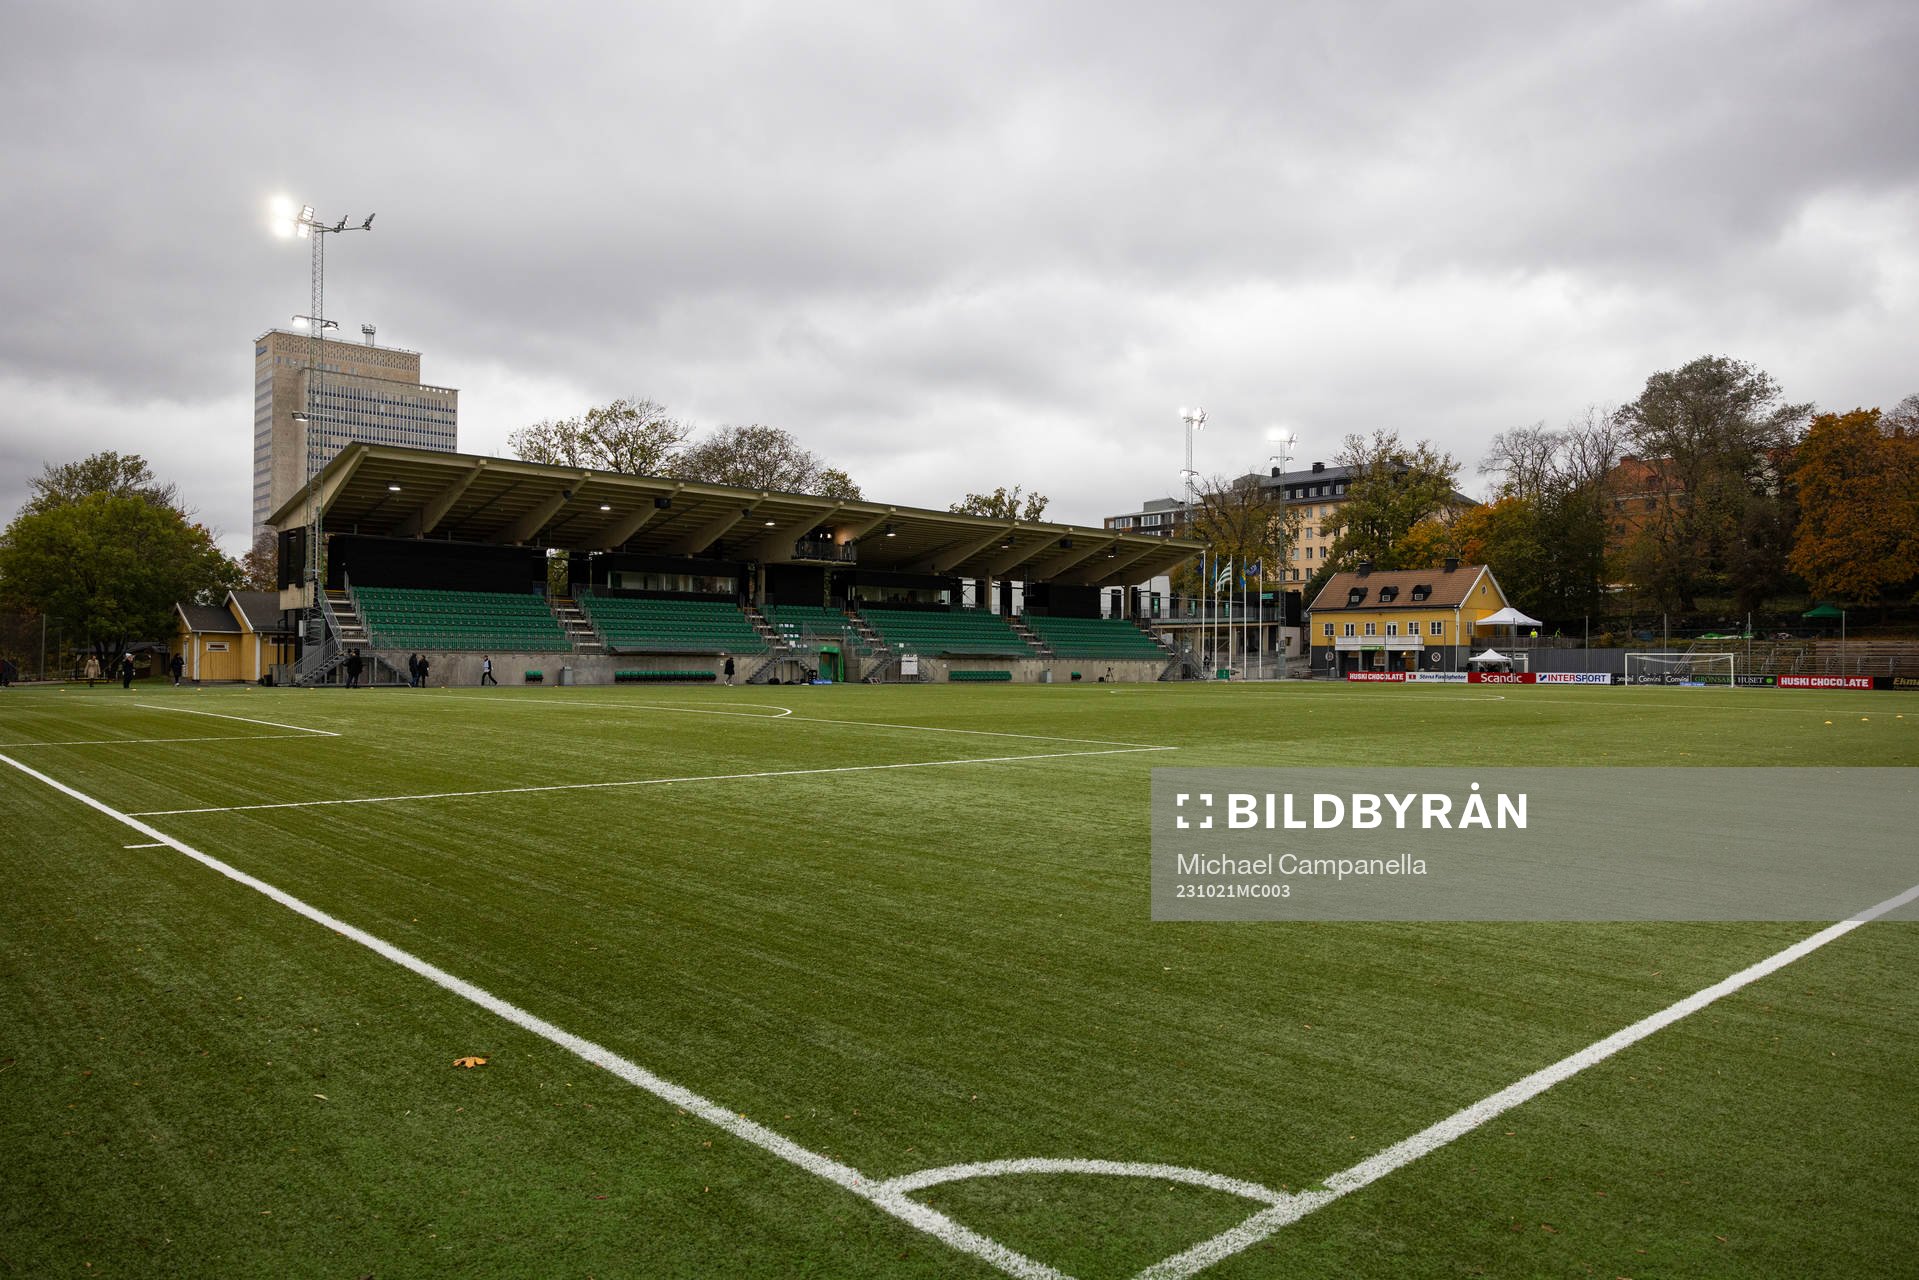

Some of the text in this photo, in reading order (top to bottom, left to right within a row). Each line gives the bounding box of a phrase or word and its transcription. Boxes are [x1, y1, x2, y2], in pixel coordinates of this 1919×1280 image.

[1480, 673, 1522, 683] Scandic
[1548, 674, 1606, 682] INTERSPORT
[1638, 675, 1661, 683] Convini
[1737, 676, 1764, 684] HUSET
[1781, 677, 1869, 687] HUSKI CHOCOLATE
